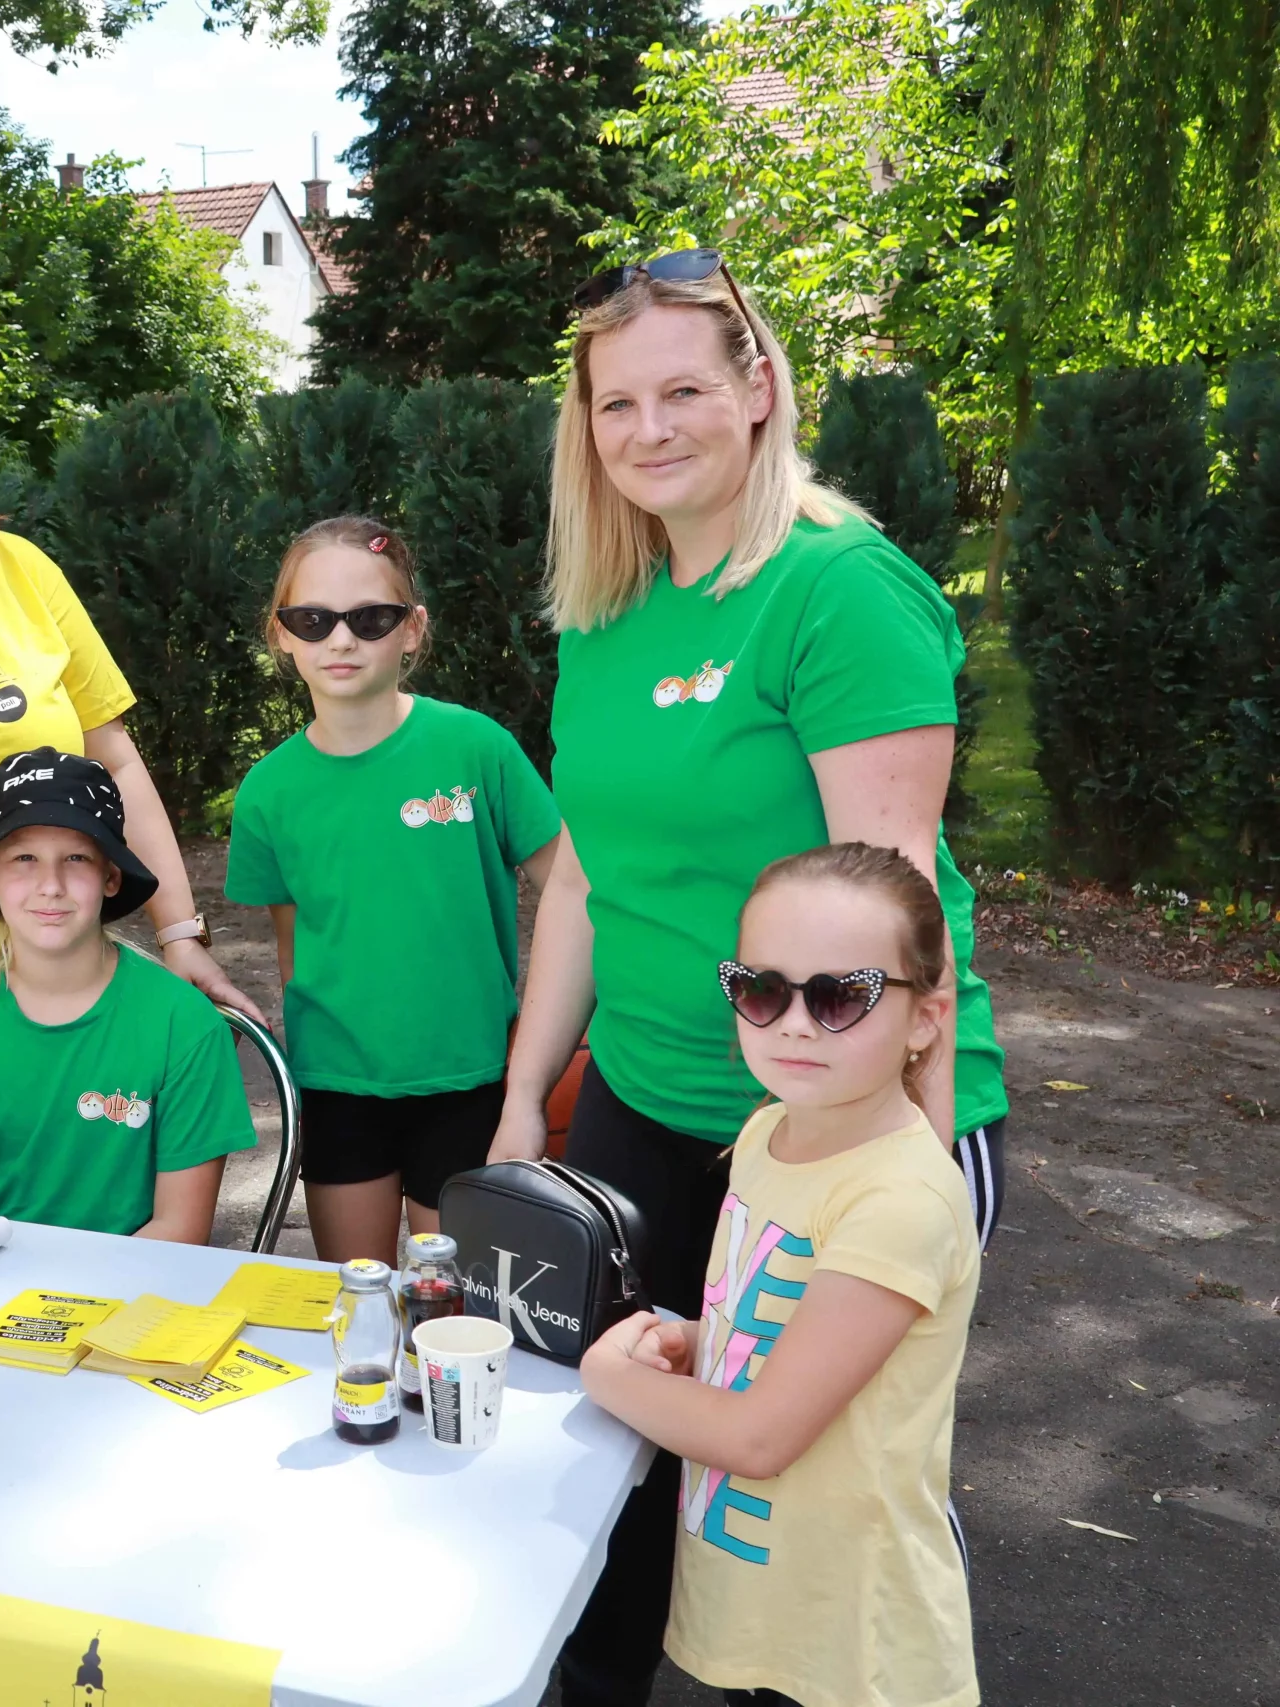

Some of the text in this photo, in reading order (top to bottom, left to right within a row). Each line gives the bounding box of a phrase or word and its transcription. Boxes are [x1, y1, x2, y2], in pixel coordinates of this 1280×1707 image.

[0, 699, 16, 710] poli
[3, 768, 55, 792] AXE
[461, 1276, 491, 1300] alvin
[530, 1301, 580, 1332] Jeans
